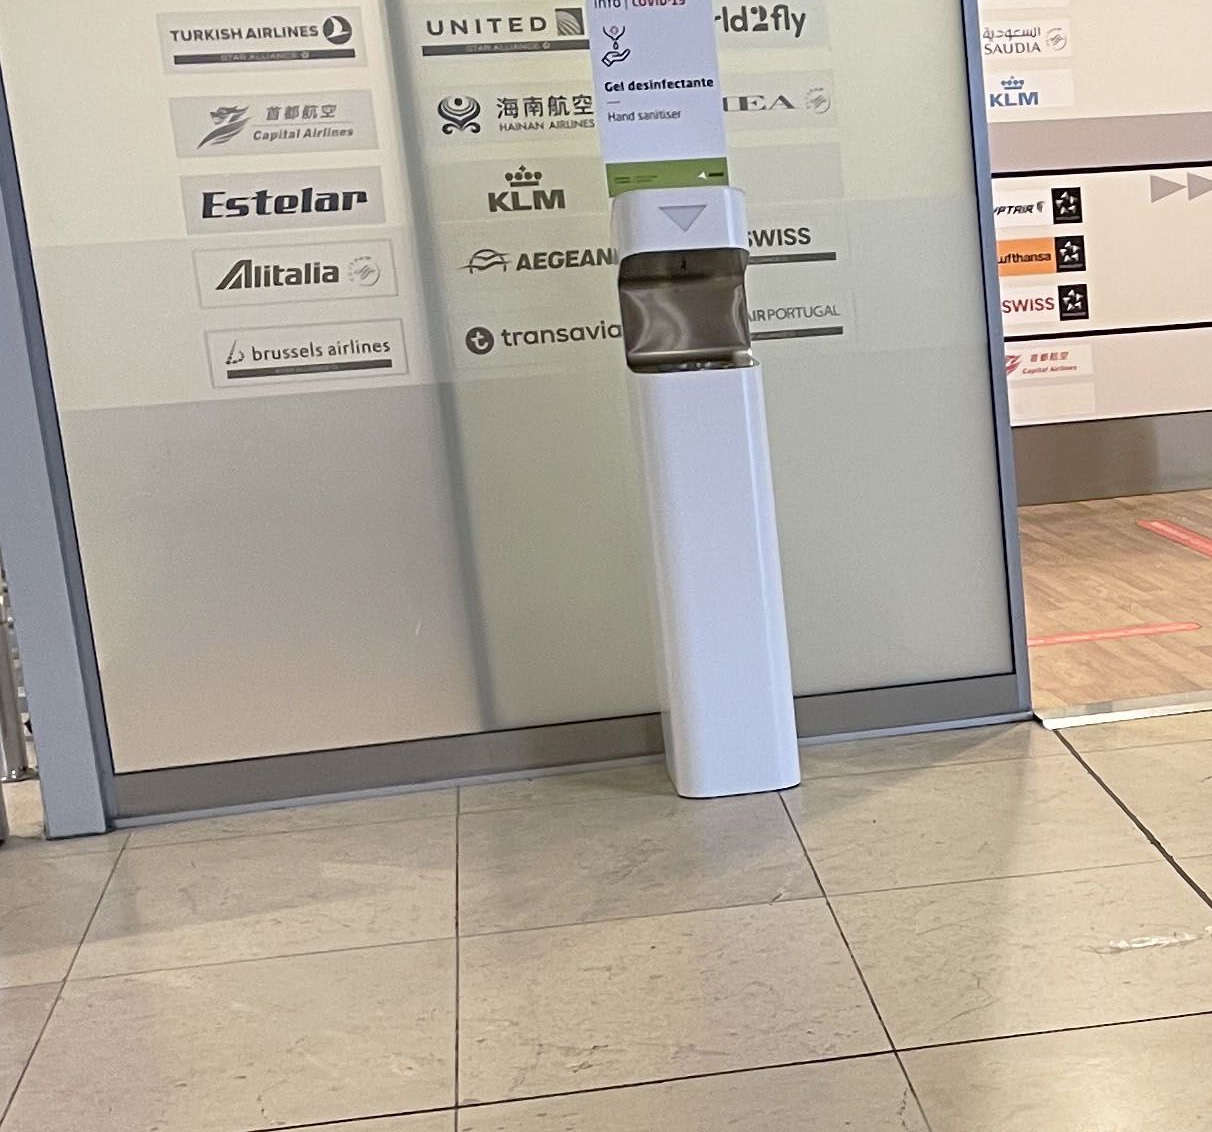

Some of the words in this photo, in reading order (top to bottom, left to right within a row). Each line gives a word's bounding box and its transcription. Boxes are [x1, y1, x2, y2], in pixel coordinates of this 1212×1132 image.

[427, 16, 547, 36] UNITED
[714, 4, 806, 38] ld2fly
[170, 28, 242, 42] TURKISH
[246, 25, 319, 39] AIRLINES
[984, 42, 1041, 55] SAUDIA
[604, 81, 624, 92] Gel
[628, 78, 714, 91] desinfectante
[497, 94, 594, 119] 海南航空
[722, 95, 795, 112] EA
[989, 91, 1039, 107] KLM
[266, 104, 337, 120] 首都航空
[607, 111, 635, 122] Hand
[638, 110, 681, 120] sanitiser
[253, 128, 301, 141] Capital
[303, 127, 353, 138] Airlines
[500, 121, 544, 131] HAINAN
[549, 119, 595, 129] AIRLINES
[201, 187, 368, 218] Estelar
[488, 189, 566, 212] KLM
[748, 227, 811, 247] WISS
[516, 248, 614, 271] AEGEAN
[215, 259, 339, 290] Alitalia
[1002, 297, 1055, 314] SWISS
[501, 320, 622, 347] transavia
[252, 341, 323, 361] brussels
[328, 339, 390, 355] airlines
